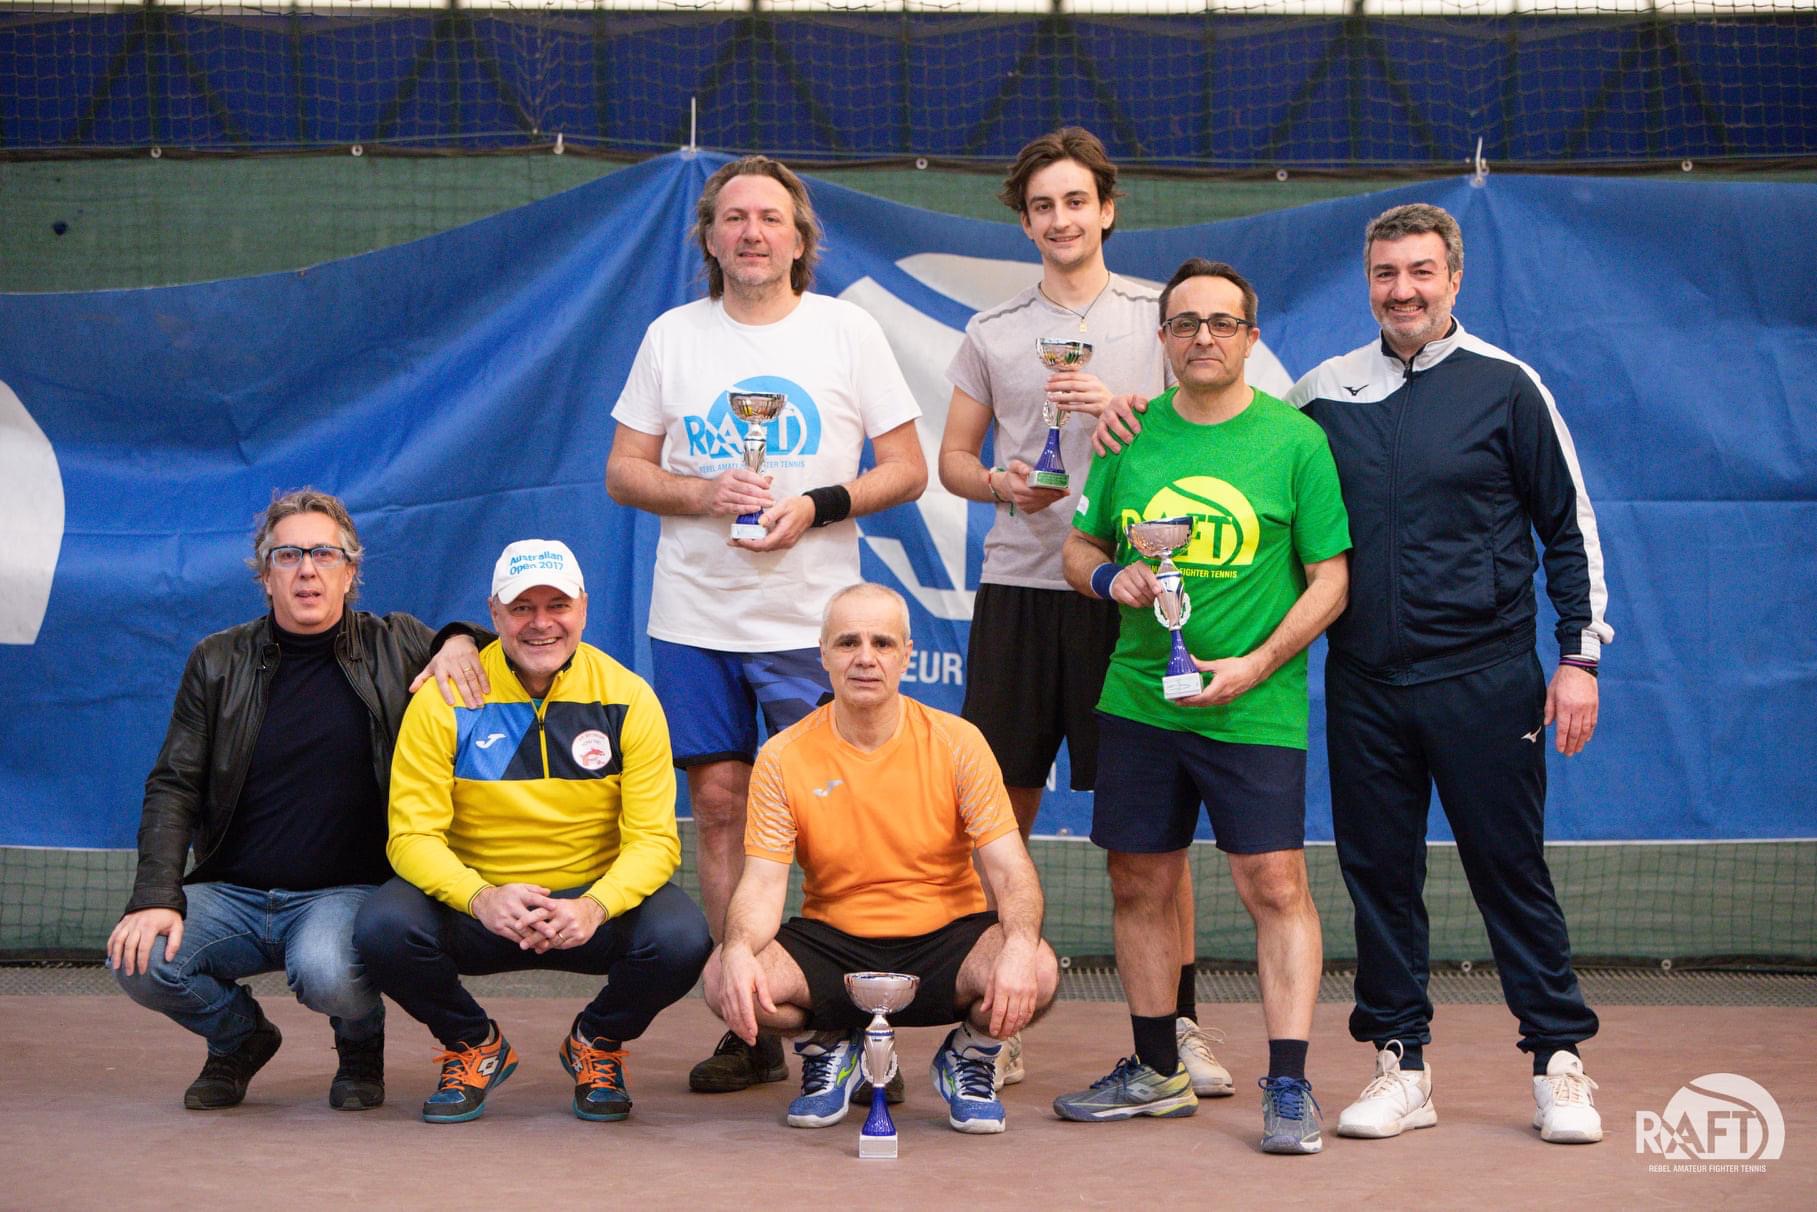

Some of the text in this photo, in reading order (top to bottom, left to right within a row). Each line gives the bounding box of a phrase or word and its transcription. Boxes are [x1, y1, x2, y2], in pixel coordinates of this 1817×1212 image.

[510, 551, 564, 566] Australian
[510, 561, 564, 575] Open 2017
[1211, 570, 1238, 579] TENNIS
